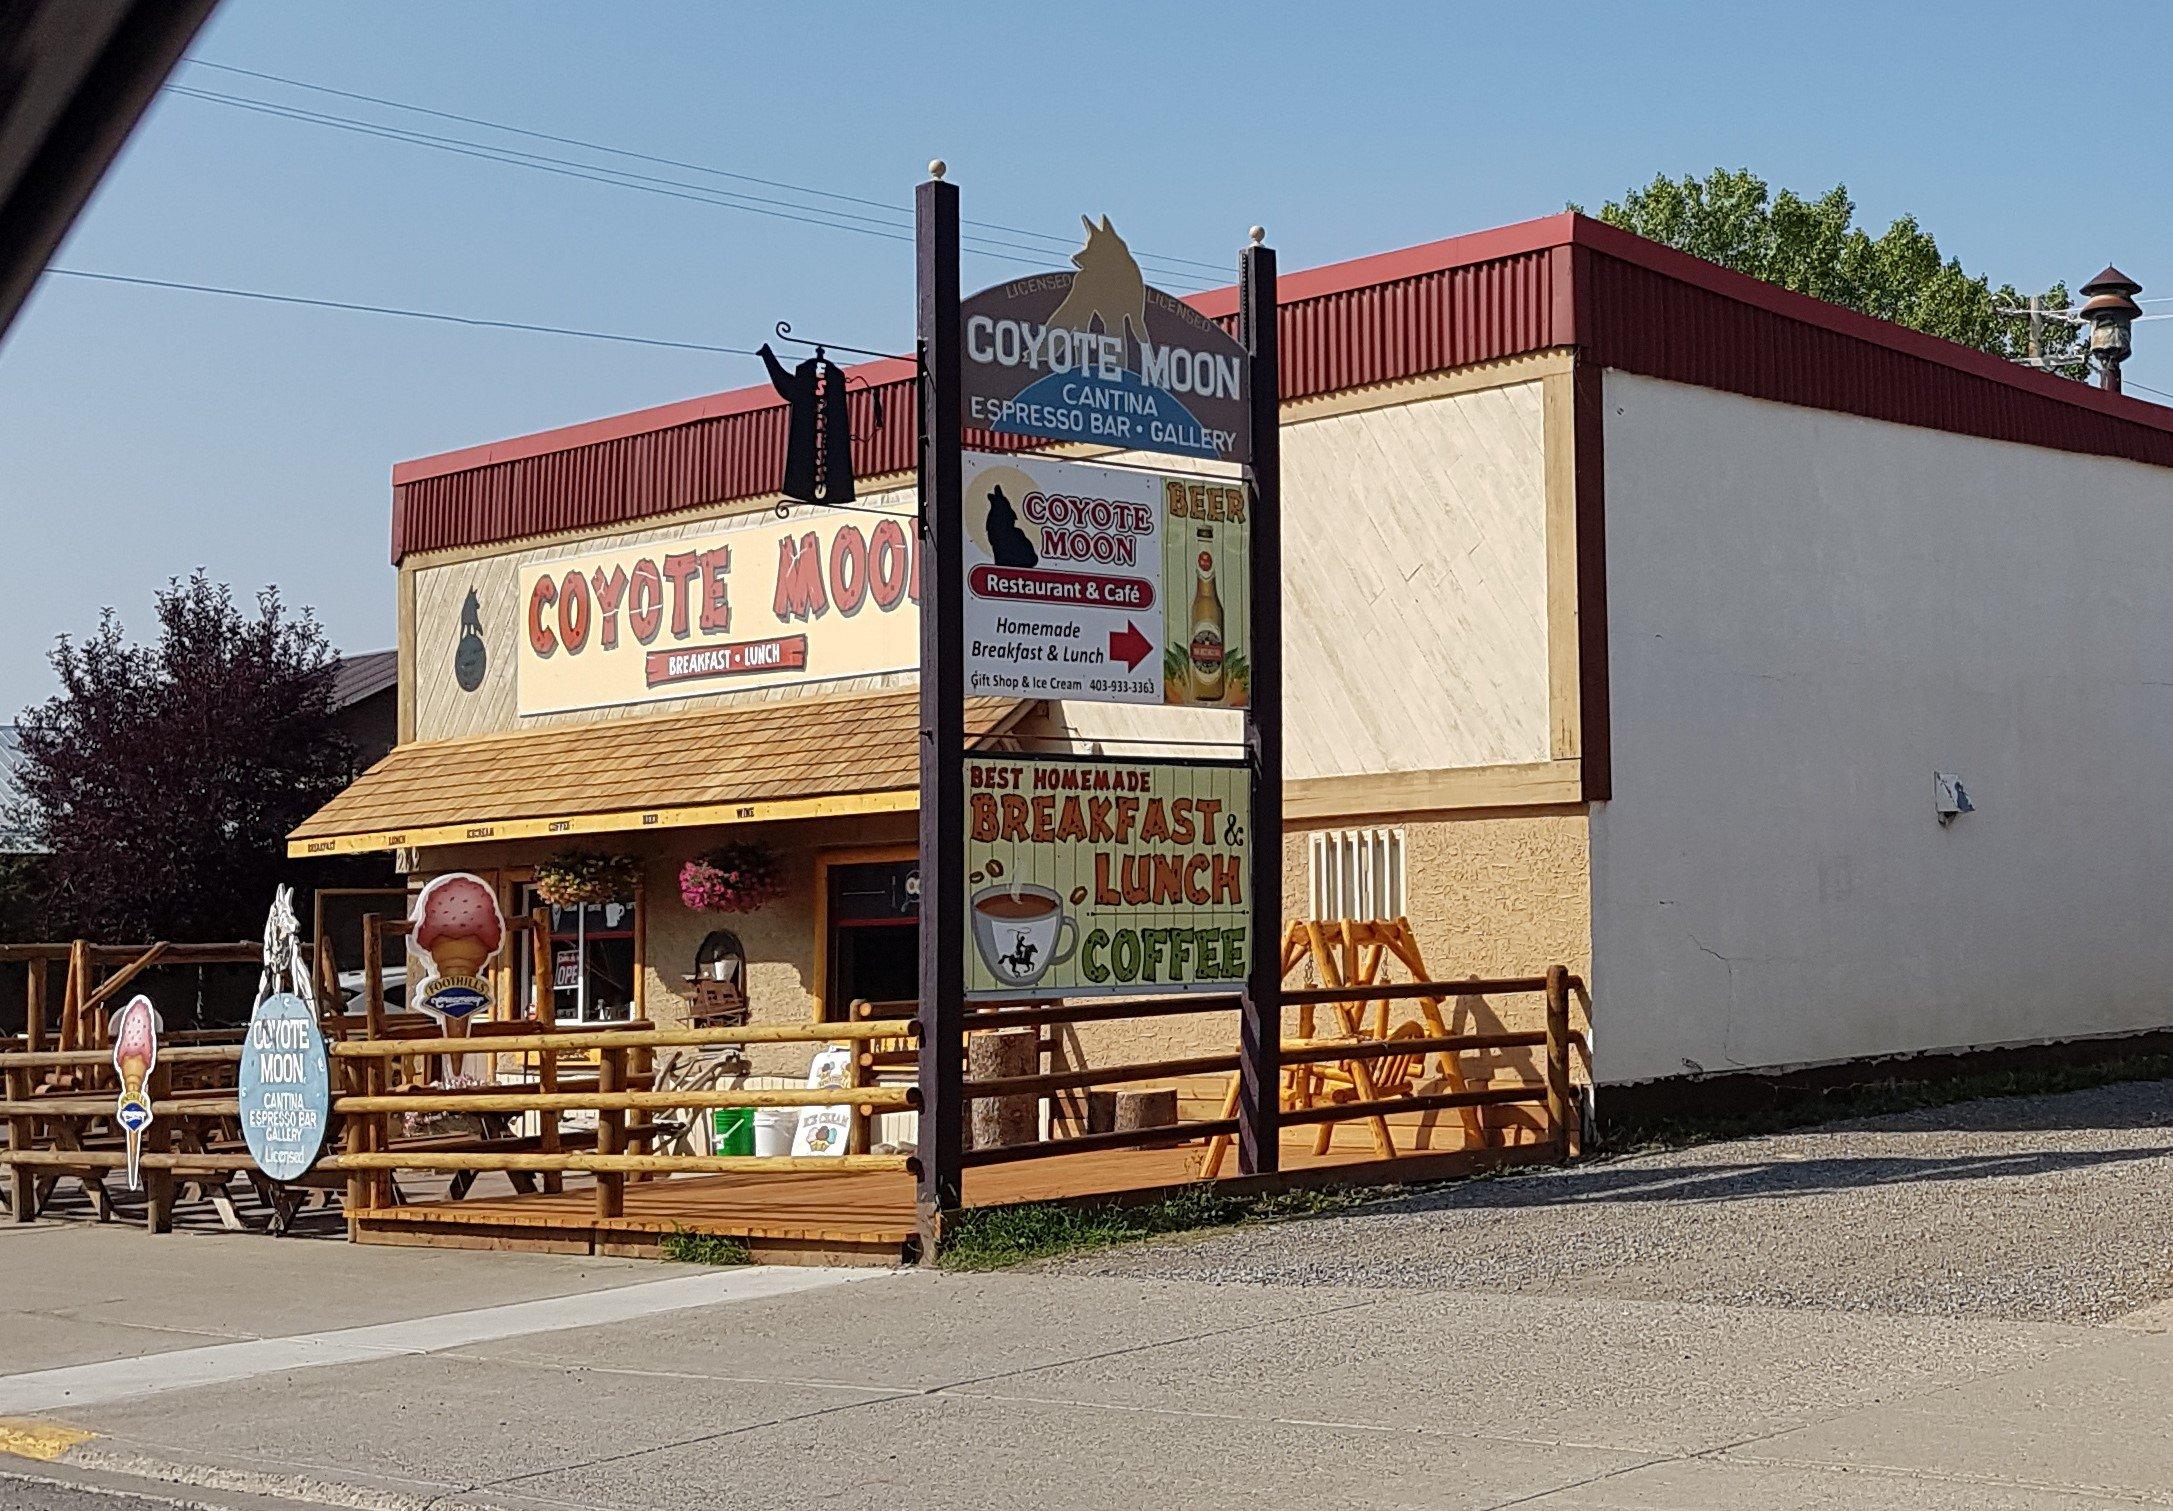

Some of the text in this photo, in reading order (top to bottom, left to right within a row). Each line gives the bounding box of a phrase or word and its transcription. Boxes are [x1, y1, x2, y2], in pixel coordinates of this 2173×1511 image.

[1006, 275, 1073, 299] LICENSED
[1148, 290, 1212, 333] LICENSED
[967, 315, 1240, 400] COYOTE MOON
[1062, 384, 1158, 417] CANTINA
[971, 396, 1237, 452] ESPRESSO BAR GALLERY
[1024, 492, 1154, 535] COYOTE
[1167, 482, 1246, 524] BEER
[1041, 527, 1137, 567] MOON
[528, 518, 920, 659] COYOTE MOO
[987, 574, 1140, 603] Restaurant & Café
[997, 617, 1080, 639] Homemade
[668, 643, 780, 676] BREAKFAST LUNCH
[972, 641, 1104, 664] Breakfast & Lunch
[971, 673, 1155, 694] Gift Shop & Ice Cream 403-933-3363
[970, 766, 1150, 793] BEST HOMEMADE
[970, 792, 1243, 846] BREAKFAST &
[1094, 852, 1242, 906] LUNCH
[1082, 927, 1246, 983] COFFEE
[253, 1019, 309, 1049] COYOTE
[260, 1054, 304, 1083] MOON
[264, 1093, 304, 1110] CANTINA
[250, 1111, 316, 1128] ESPRESSO BAR
[266, 1127, 302, 1142] GALLERY
[265, 1145, 305, 1164] Licensed
